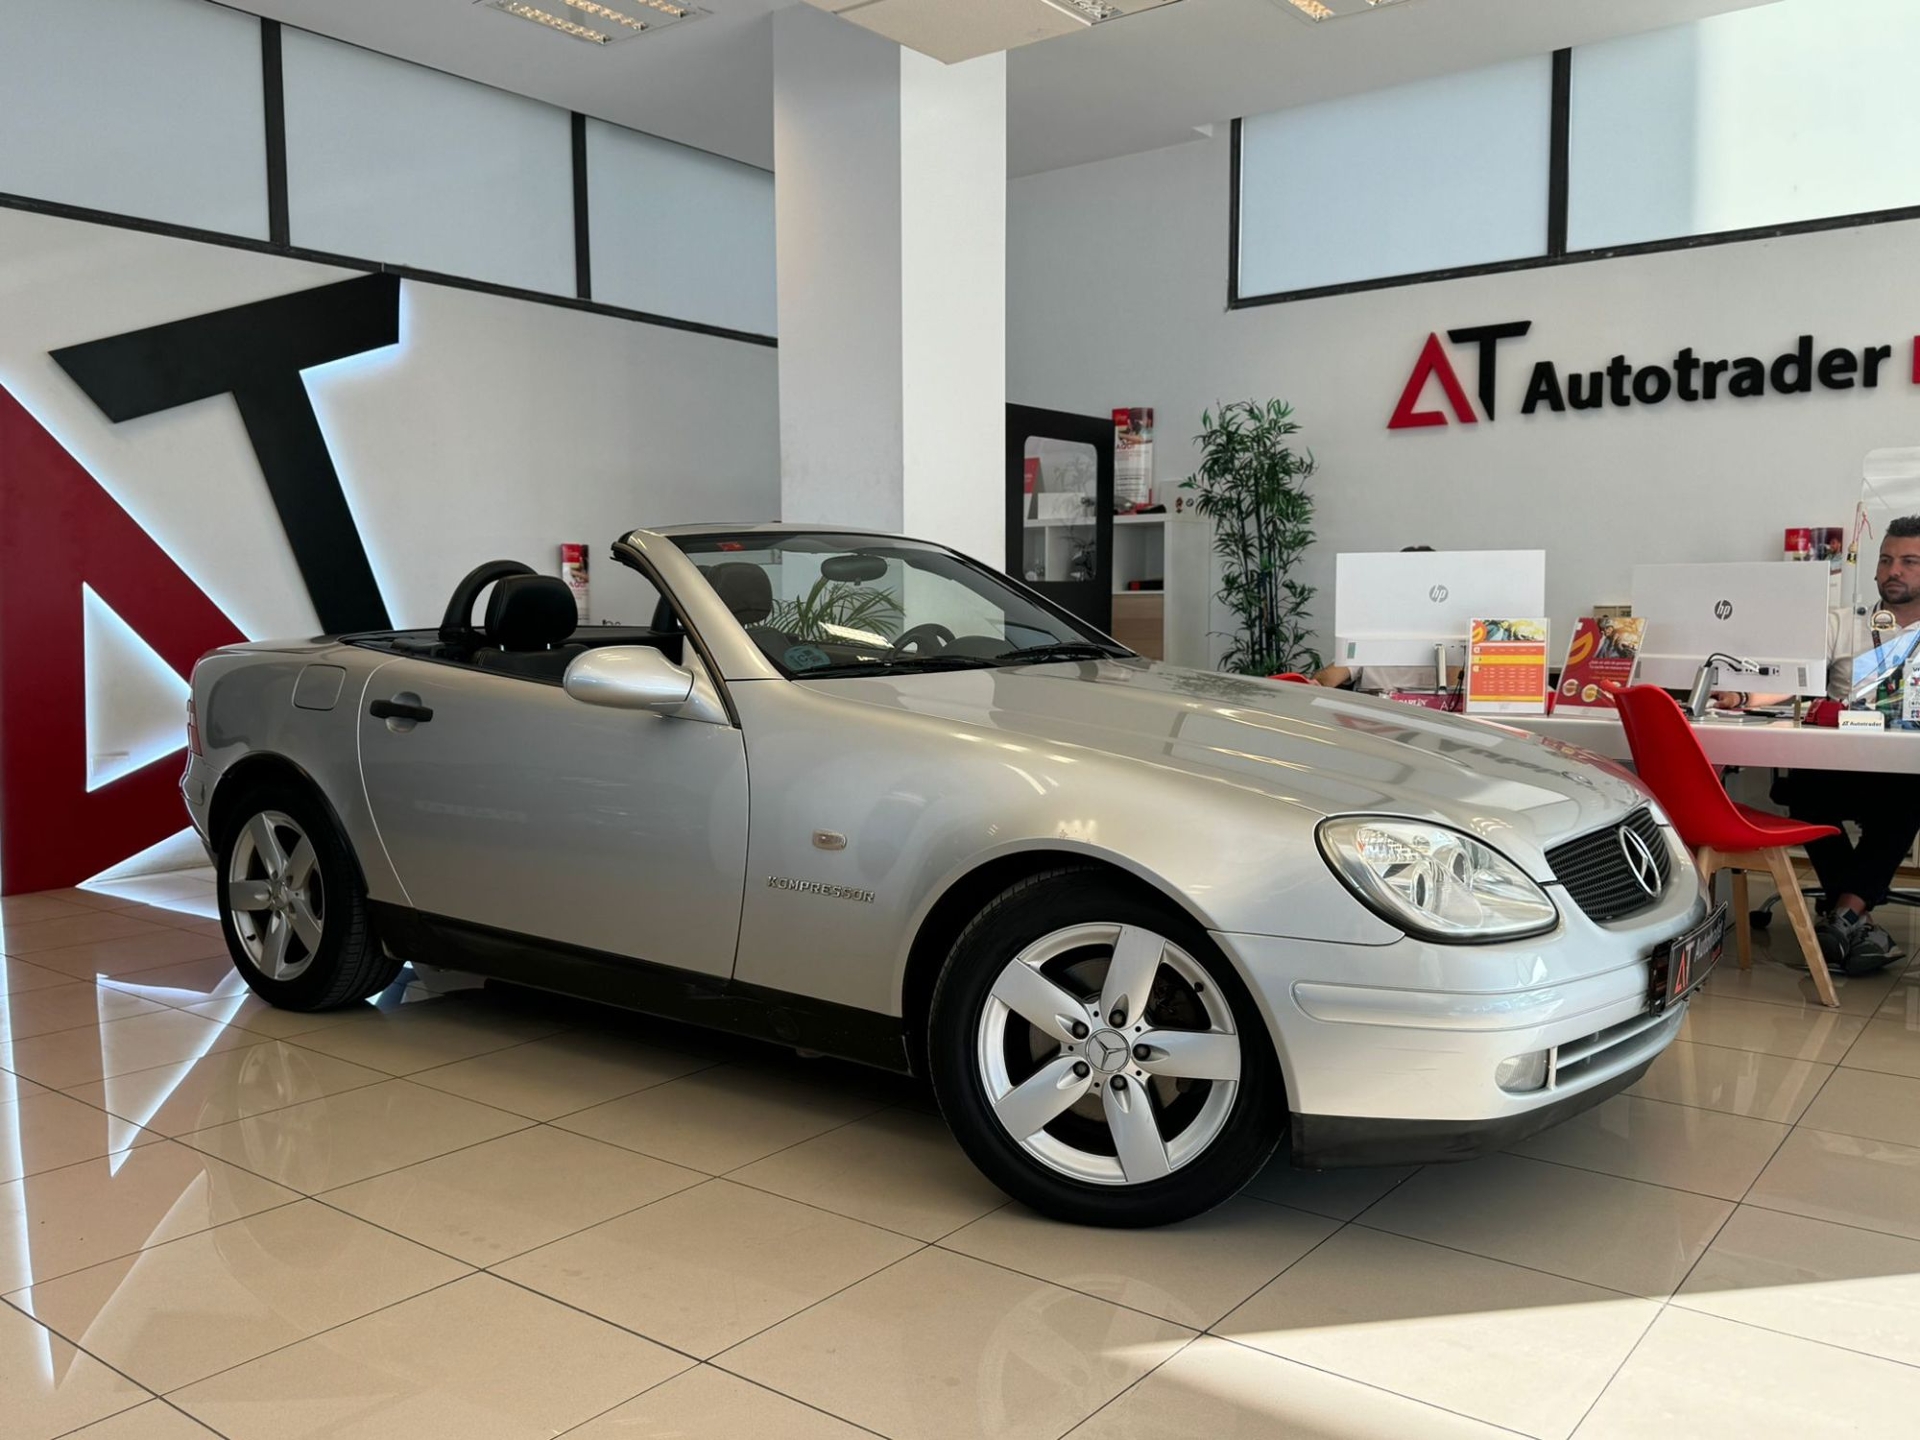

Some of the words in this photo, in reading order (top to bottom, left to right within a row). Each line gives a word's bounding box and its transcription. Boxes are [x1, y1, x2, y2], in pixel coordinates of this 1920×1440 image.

[1386, 320, 1533, 430] AT
[1521, 335, 1892, 414] Autotrader
[1429, 584, 1449, 603] hp
[1714, 600, 1733, 620] hp
[767, 875, 876, 903] KOMPRESSOR
